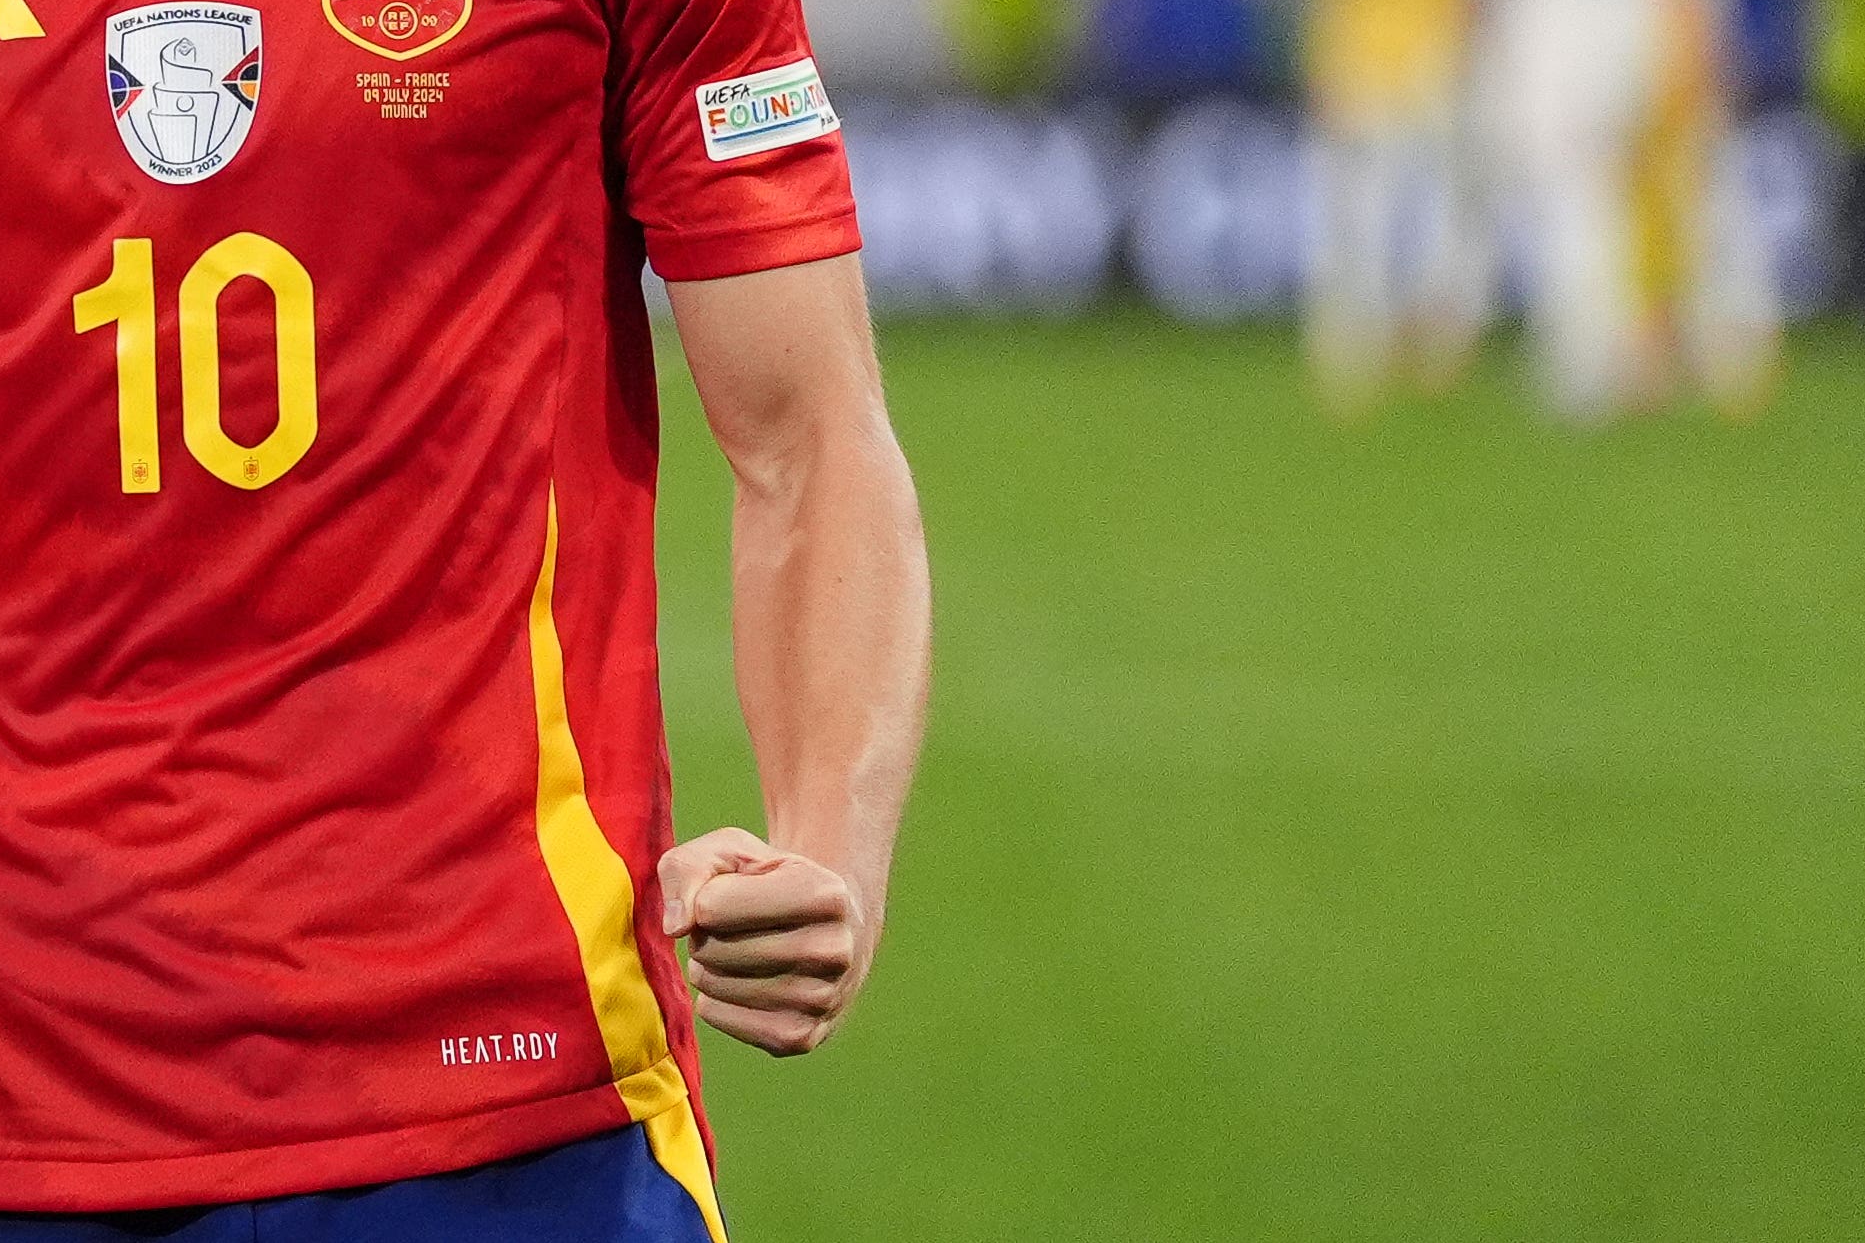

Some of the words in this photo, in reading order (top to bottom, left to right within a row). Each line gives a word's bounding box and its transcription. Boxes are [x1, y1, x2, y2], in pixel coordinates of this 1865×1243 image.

[114, 16, 143, 32] UEFA
[147, 9, 201, 24] NATIONS
[204, 9, 253, 25] LEAGUE
[356, 72, 391, 87] SPAIN
[405, 72, 450, 87] FRANCE
[363, 88, 379, 103] 09
[382, 88, 409, 103] JULY
[412, 88, 443, 103] 2024
[704, 83, 751, 106] UEFA
[381, 104, 427, 118] MUNICH
[148, 158, 193, 177] WINNER
[196, 154, 223, 174] 2023
[73, 231, 319, 494] 10
[441, 1032, 557, 1066] HEAT.RDY
